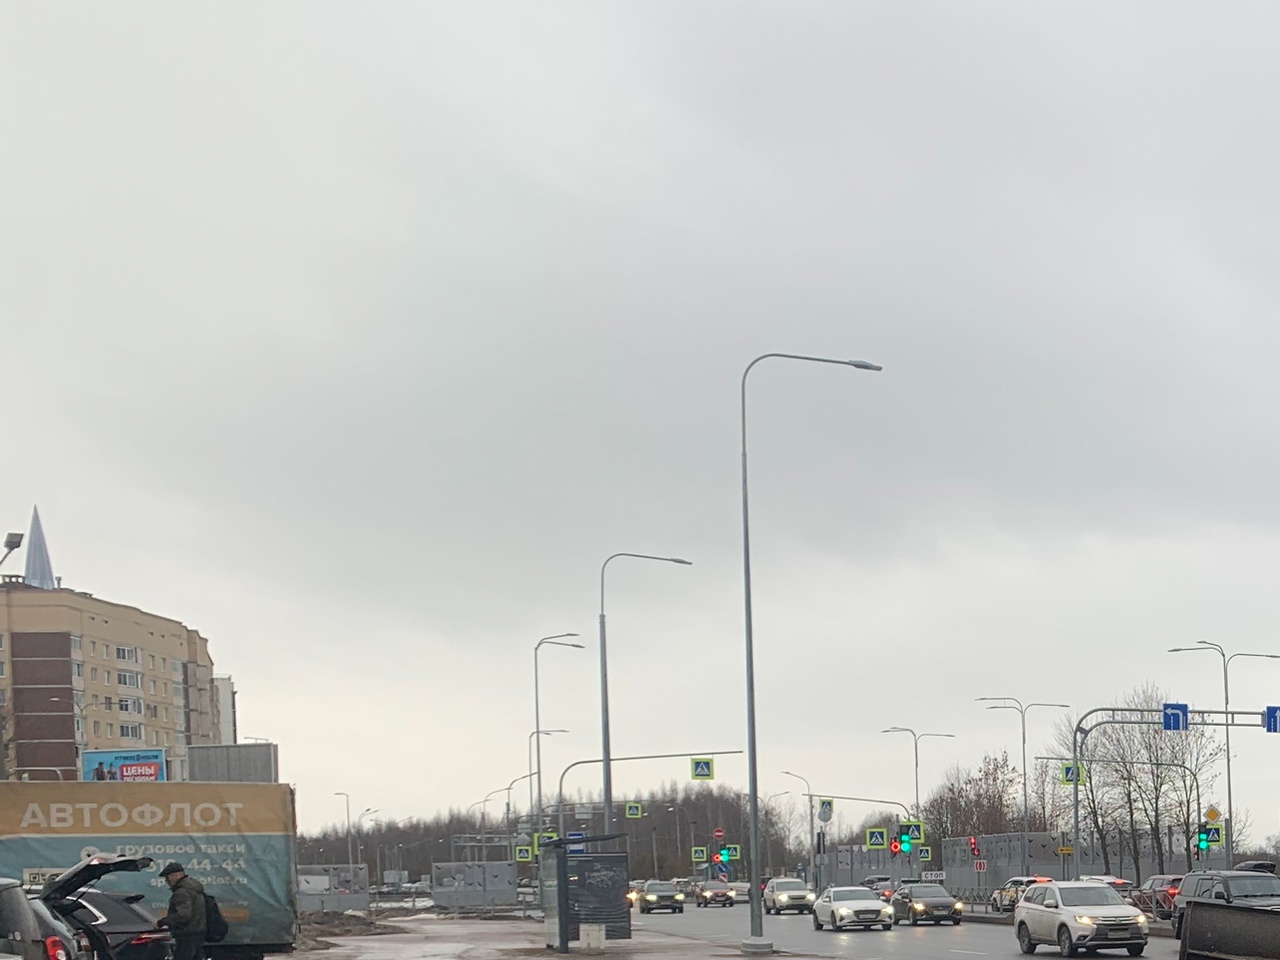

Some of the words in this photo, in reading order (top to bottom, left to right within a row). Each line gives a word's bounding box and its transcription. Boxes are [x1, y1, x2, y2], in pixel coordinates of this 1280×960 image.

[123, 766, 155, 776] ЦЕНЫ
[20, 802, 244, 828] АВТОФЛОТ
[117, 844, 195, 857] грузовое
[199, 843, 246, 854] такси
[146, 858, 247, 873] 31-44-44
